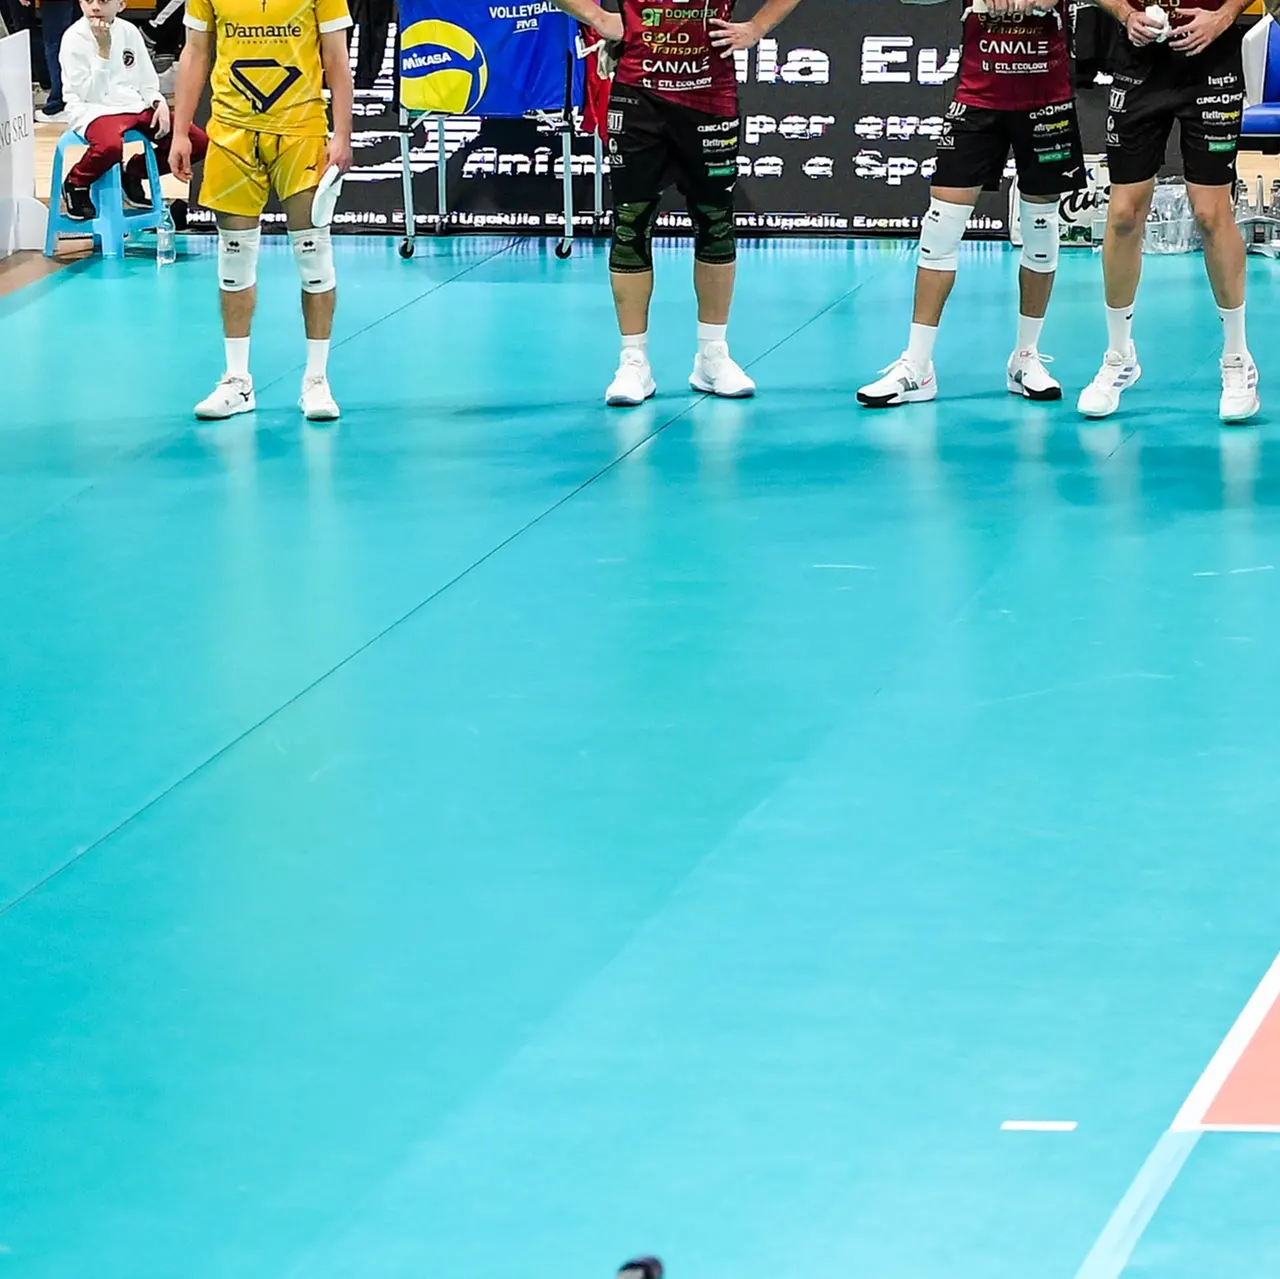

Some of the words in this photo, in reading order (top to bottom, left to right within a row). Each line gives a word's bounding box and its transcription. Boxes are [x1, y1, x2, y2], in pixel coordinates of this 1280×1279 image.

[642, 32, 690, 44] GOLD
[979, 39, 1049, 55] CANALE
[642, 56, 710, 74] CANALE
[995, 62, 1010, 70] CTL
[1012, 61, 1048, 70] ECOLOGY
